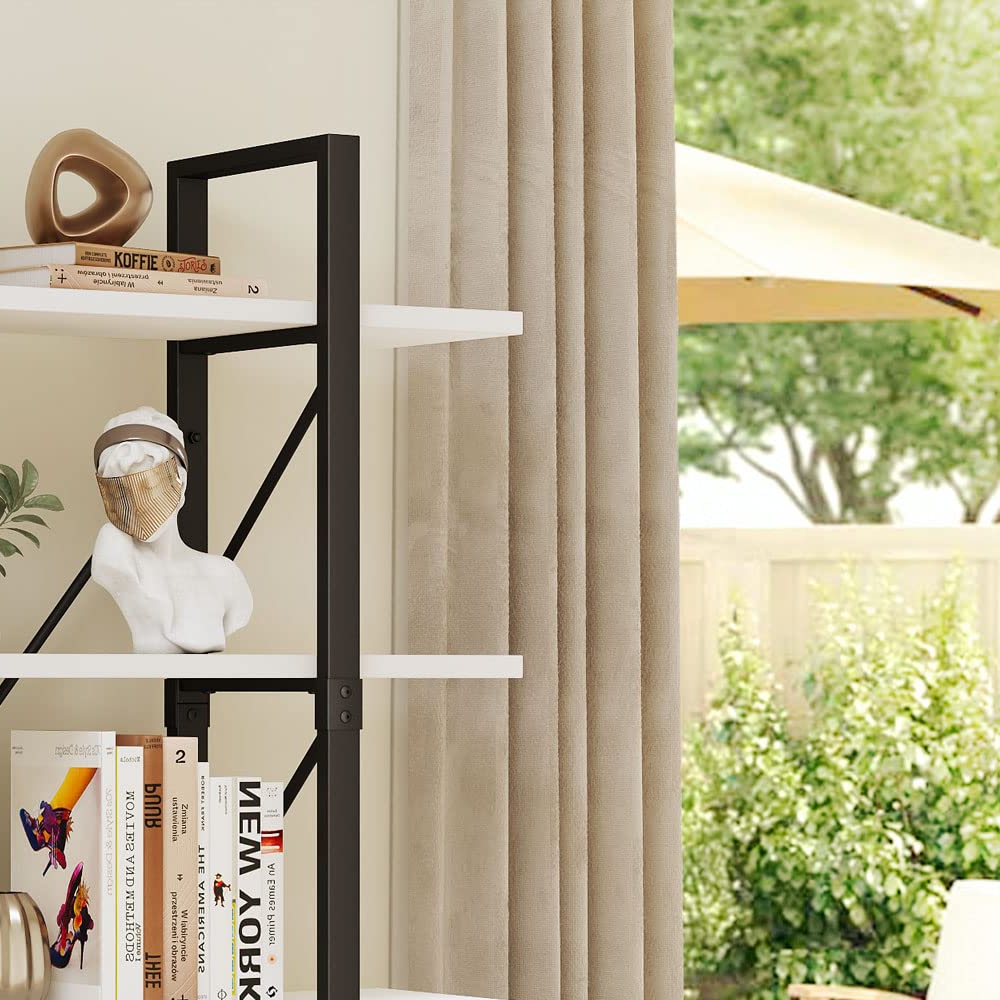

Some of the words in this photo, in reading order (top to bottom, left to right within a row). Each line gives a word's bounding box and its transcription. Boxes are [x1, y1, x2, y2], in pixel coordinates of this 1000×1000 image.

[114, 251, 158, 271] KOFFIE
[247, 285, 259, 294] 2
[175, 749, 186, 764] 2
[171, 797, 179, 842] ustawienia
[181, 803, 189, 835] Zmiana
[170, 891, 178, 938] przestrzeni
[181, 909, 188, 919] W
[179, 919, 188, 962] labiryncie
[171, 944, 179, 982] obrazów
